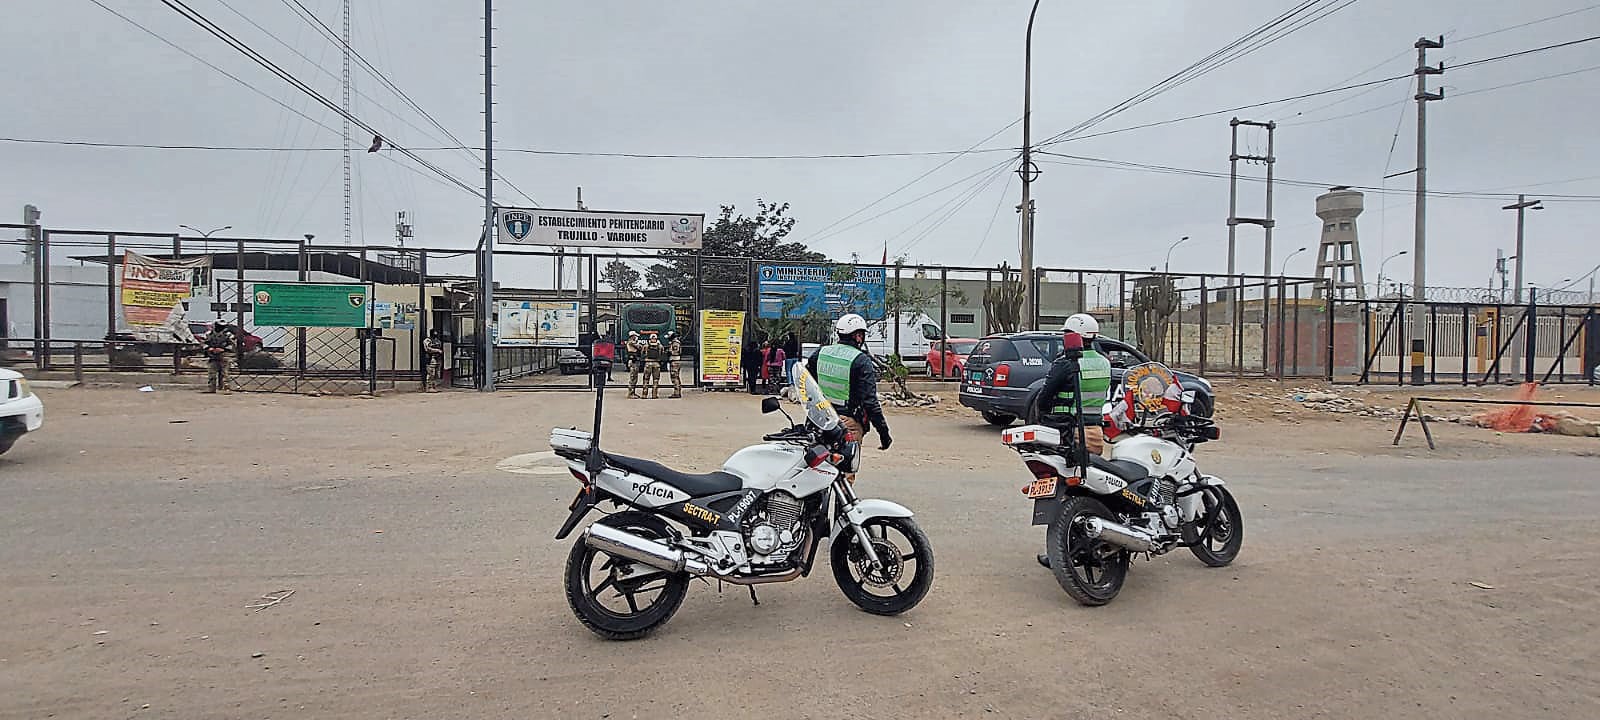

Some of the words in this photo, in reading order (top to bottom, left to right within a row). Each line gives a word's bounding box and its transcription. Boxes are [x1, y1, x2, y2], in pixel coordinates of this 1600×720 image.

[538, 215, 607, 229] ESTABLECIMIENTO
[609, 217, 665, 231] PENITENCIARIO
[557, 230, 598, 242] TRUJILLO
[606, 232, 648, 243] VARONES
[776, 266, 827, 277] MINISTERIO
[1105, 475, 1123, 488] POLICIA
[632, 482, 674, 500] POLICIA
[1122, 488, 1146, 507] SECTRA-T
[683, 502, 720, 524] SECTRA-T
[727, 490, 757, 523] PL-19097
